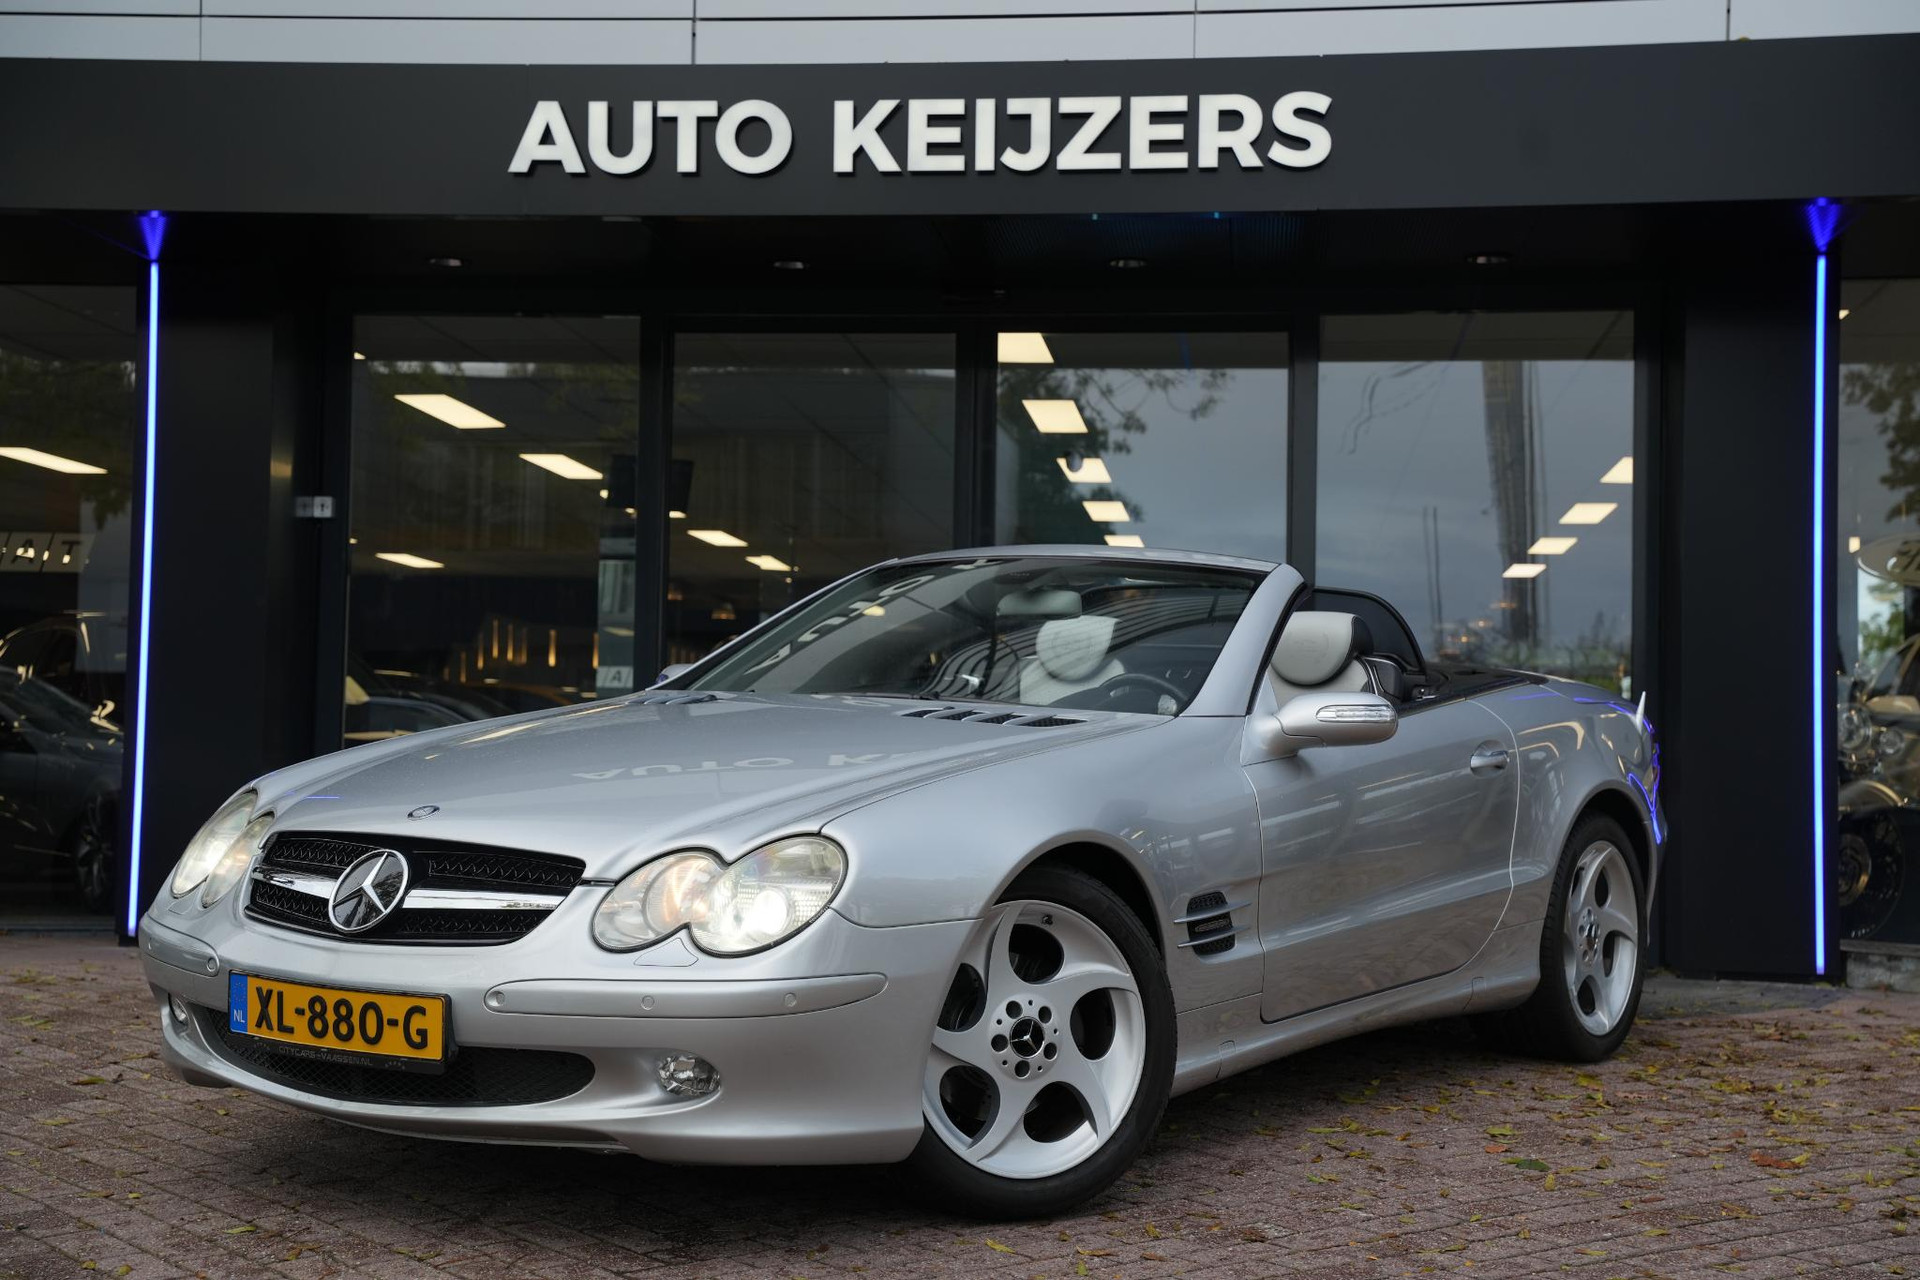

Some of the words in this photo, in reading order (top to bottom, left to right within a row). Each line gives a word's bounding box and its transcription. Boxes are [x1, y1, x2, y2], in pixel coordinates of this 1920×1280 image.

[508, 98, 793, 175] AUTO
[832, 90, 1333, 173] KEIJZERS
[233, 1008, 246, 1023] NL
[254, 986, 429, 1050] XL-880-G
